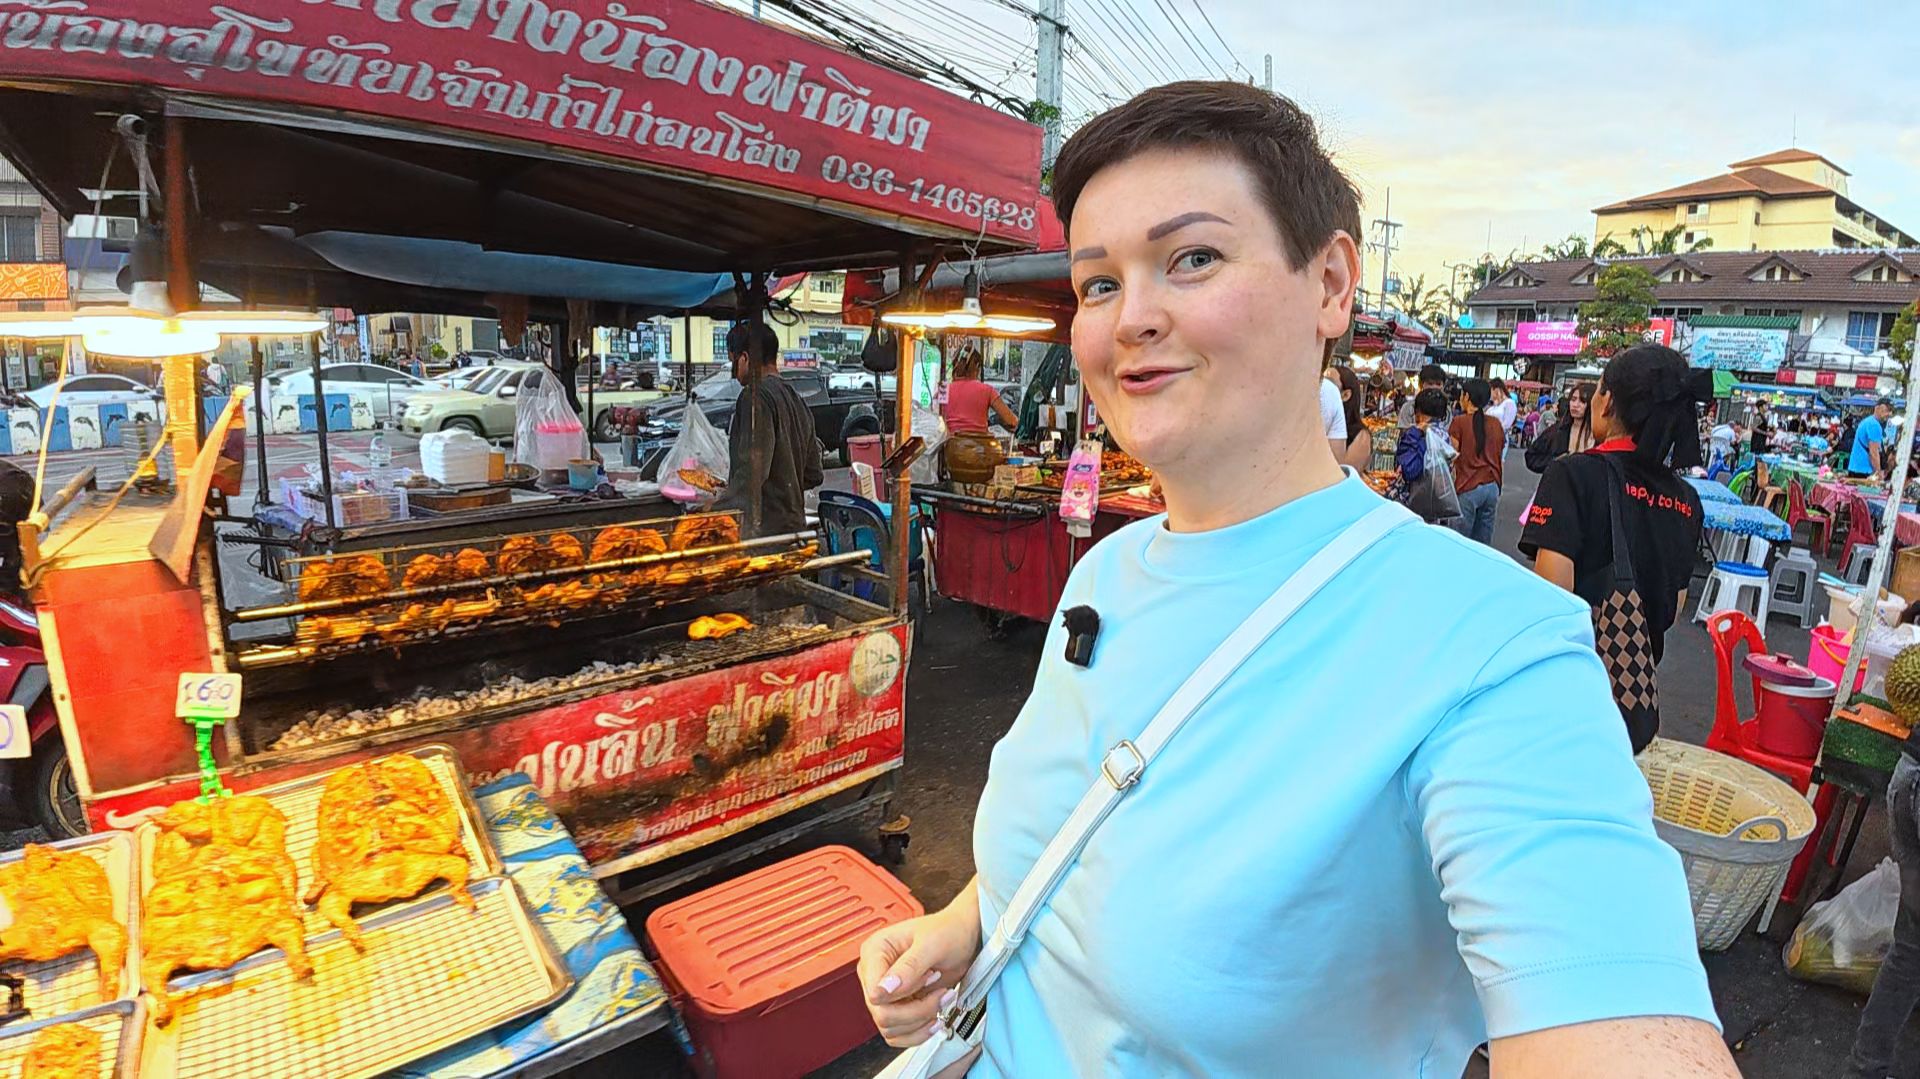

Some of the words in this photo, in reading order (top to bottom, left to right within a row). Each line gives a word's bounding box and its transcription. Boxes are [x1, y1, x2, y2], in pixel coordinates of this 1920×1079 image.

[821, 155, 1037, 232] 086-1465628
[1527, 332, 1560, 341] GOSSIP
[1657, 494, 1673, 509] to
[1531, 504, 1553, 517] Tops
